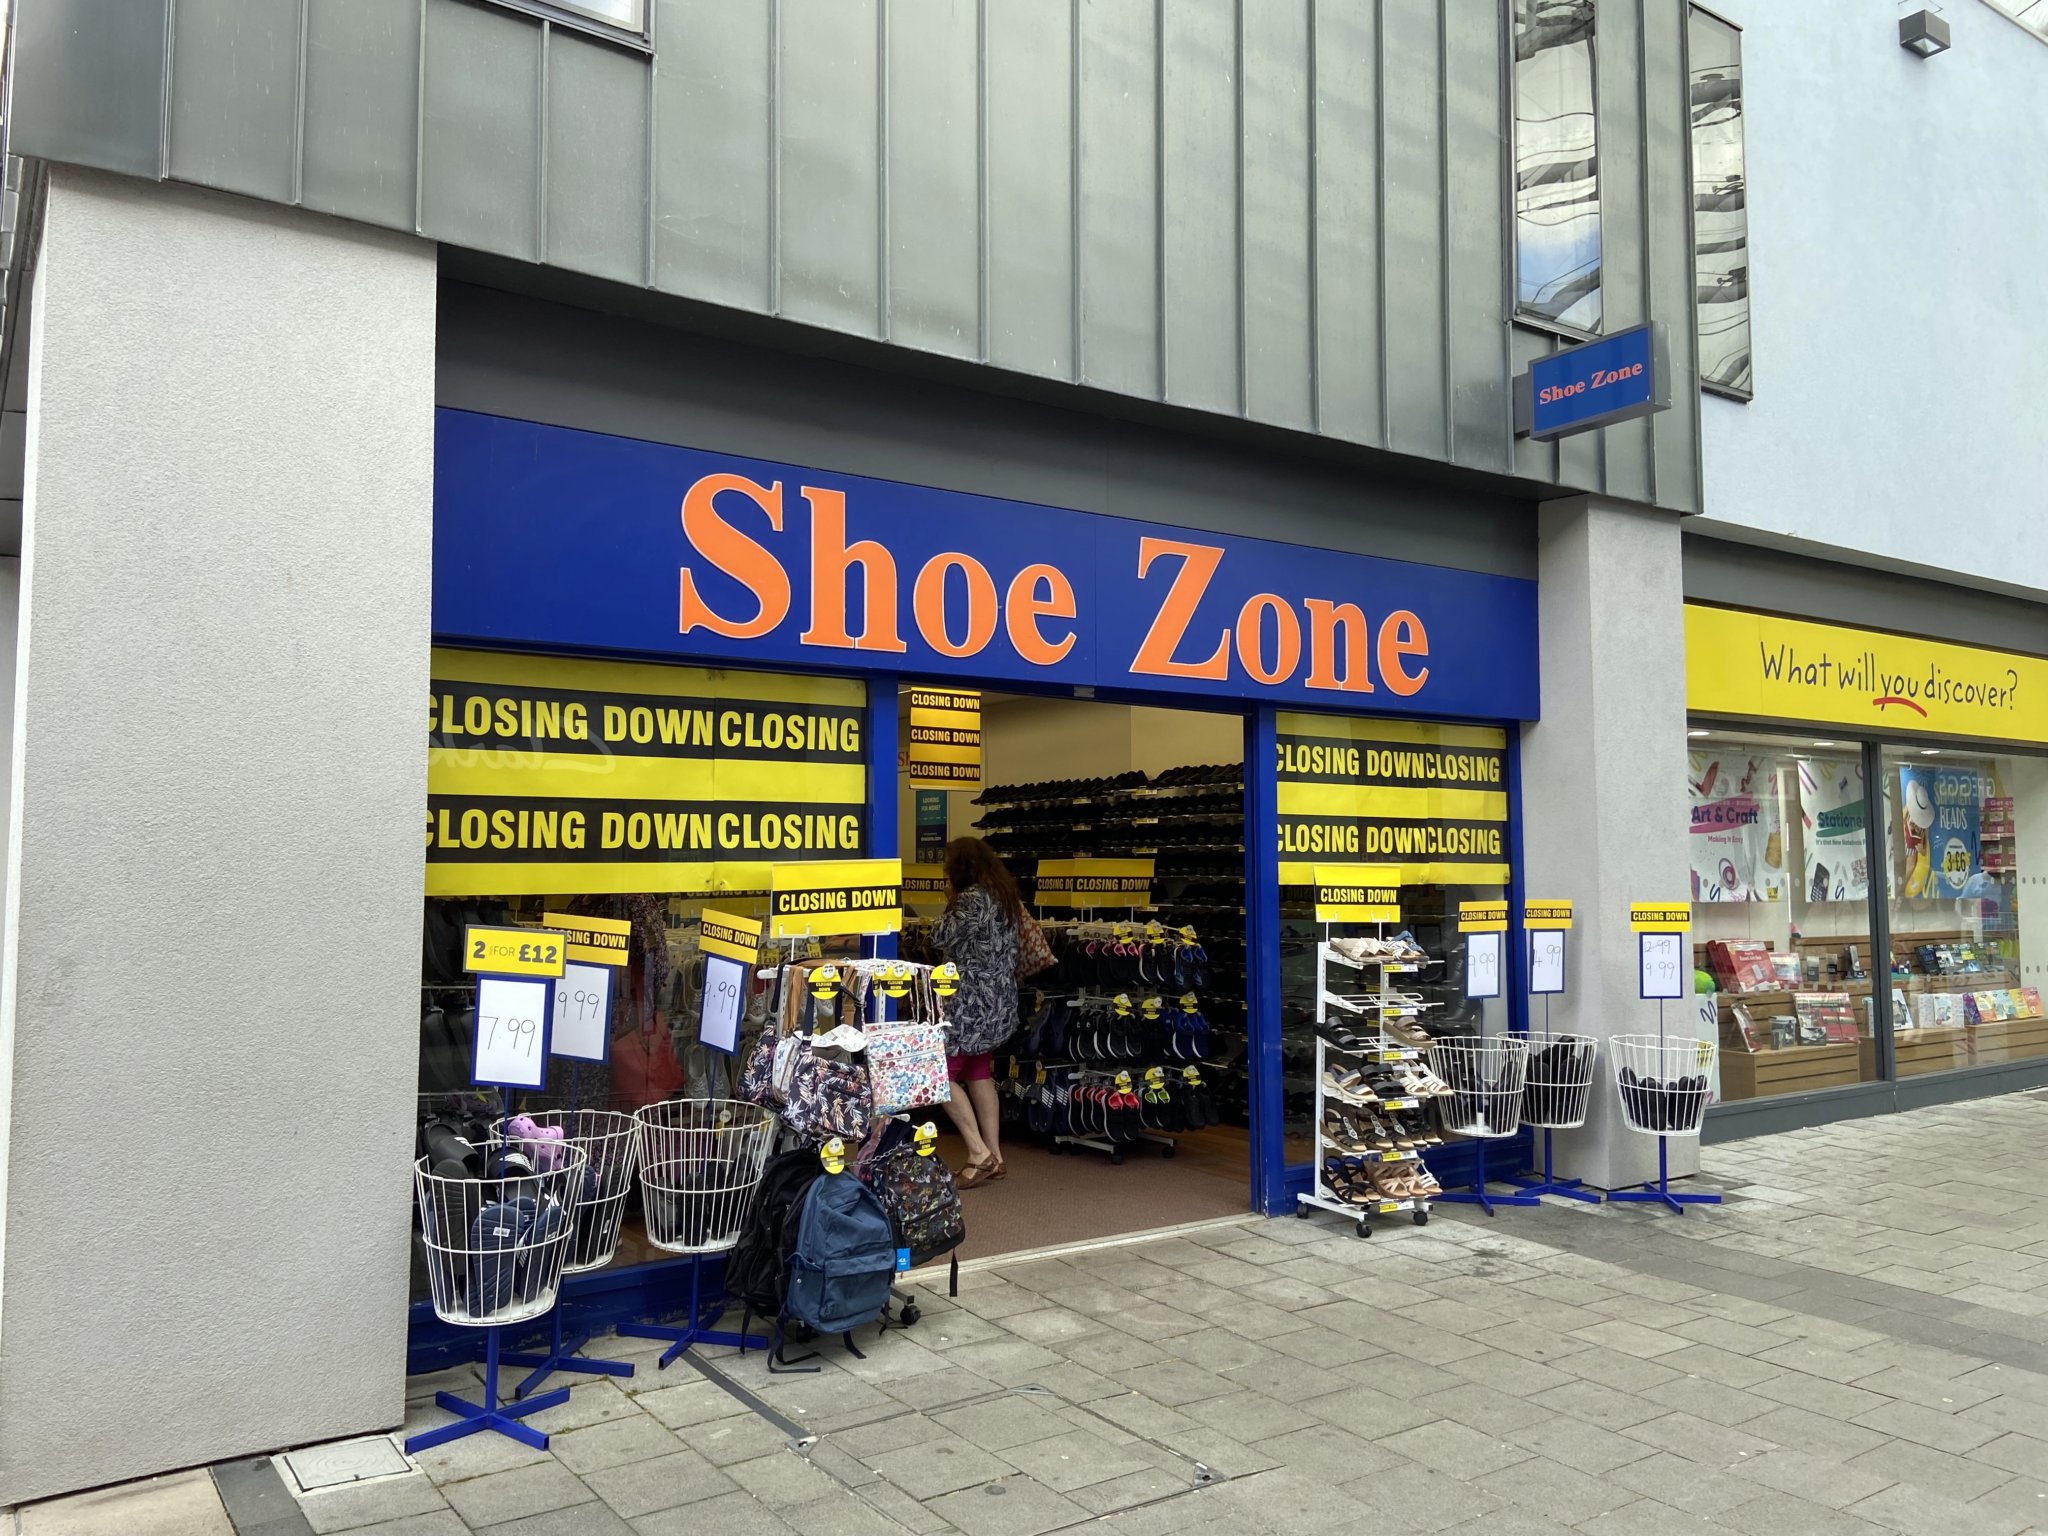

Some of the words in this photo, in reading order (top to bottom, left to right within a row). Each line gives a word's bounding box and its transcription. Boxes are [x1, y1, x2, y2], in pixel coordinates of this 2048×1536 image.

[1539, 381, 1586, 405] Shoe
[1591, 362, 1643, 390] Zone
[679, 472, 1077, 666] Shoe
[1129, 536, 1430, 696] Zone
[1760, 641, 1832, 687] What
[1838, 652, 1875, 692] will
[1881, 673, 1919, 711] you
[1924, 663, 2018, 710] discover?
[912, 693, 950, 707] CLOSING
[953, 697, 979, 709] DOWN
[604, 706, 713, 747] DOWN
[719, 710, 859, 752] CLOSING
[911, 728, 950, 742] CLOSING
[953, 732, 979, 744] DOWN
[911, 764, 950, 777] CLOSING
[953, 766, 979, 779] DOWN
[1366, 749, 1425, 778] DOWN
[1426, 752, 1499, 782] CLOSING
[1691, 806, 1711, 825] Art
[1714, 806, 1723, 824] &
[1726, 808, 1758, 825] Craft
[1939, 807, 1968, 830] READS
[425, 808, 586, 850] LOSING
[602, 811, 712, 849] DOWN
[718, 812, 859, 850] CLOSING
[1366, 826, 1426, 853] DOWN
[1427, 826, 1500, 854] CLOSING
[901, 879, 931, 890] LOSING
[1037, 878, 1063, 890] CLOSING
[1076, 878, 1119, 891] CLOSING
[1121, 878, 1150, 891] DOWN
[779, 891, 849, 912] CLOSING
[852, 888, 897, 907] DOWN
[1320, 889, 1364, 903] CLOSING
[1367, 889, 1397, 903] DOWN
[1460, 911, 1487, 921] CLOSING
[1487, 910, 1506, 920] DOWN
[1526, 909, 1551, 918] CLOSING
[1552, 909, 1570, 918] DOWN
[1633, 912, 1664, 921] CLOSING
[1666, 912, 1688, 921] DOWN
[593, 933, 626, 948] DOWN
[702, 923, 733, 941] CLOSING
[734, 931, 757, 948] DOWN
[473, 940, 486, 959] 2
[493, 946, 515, 957] FOR
[519, 943, 557, 964] £12
